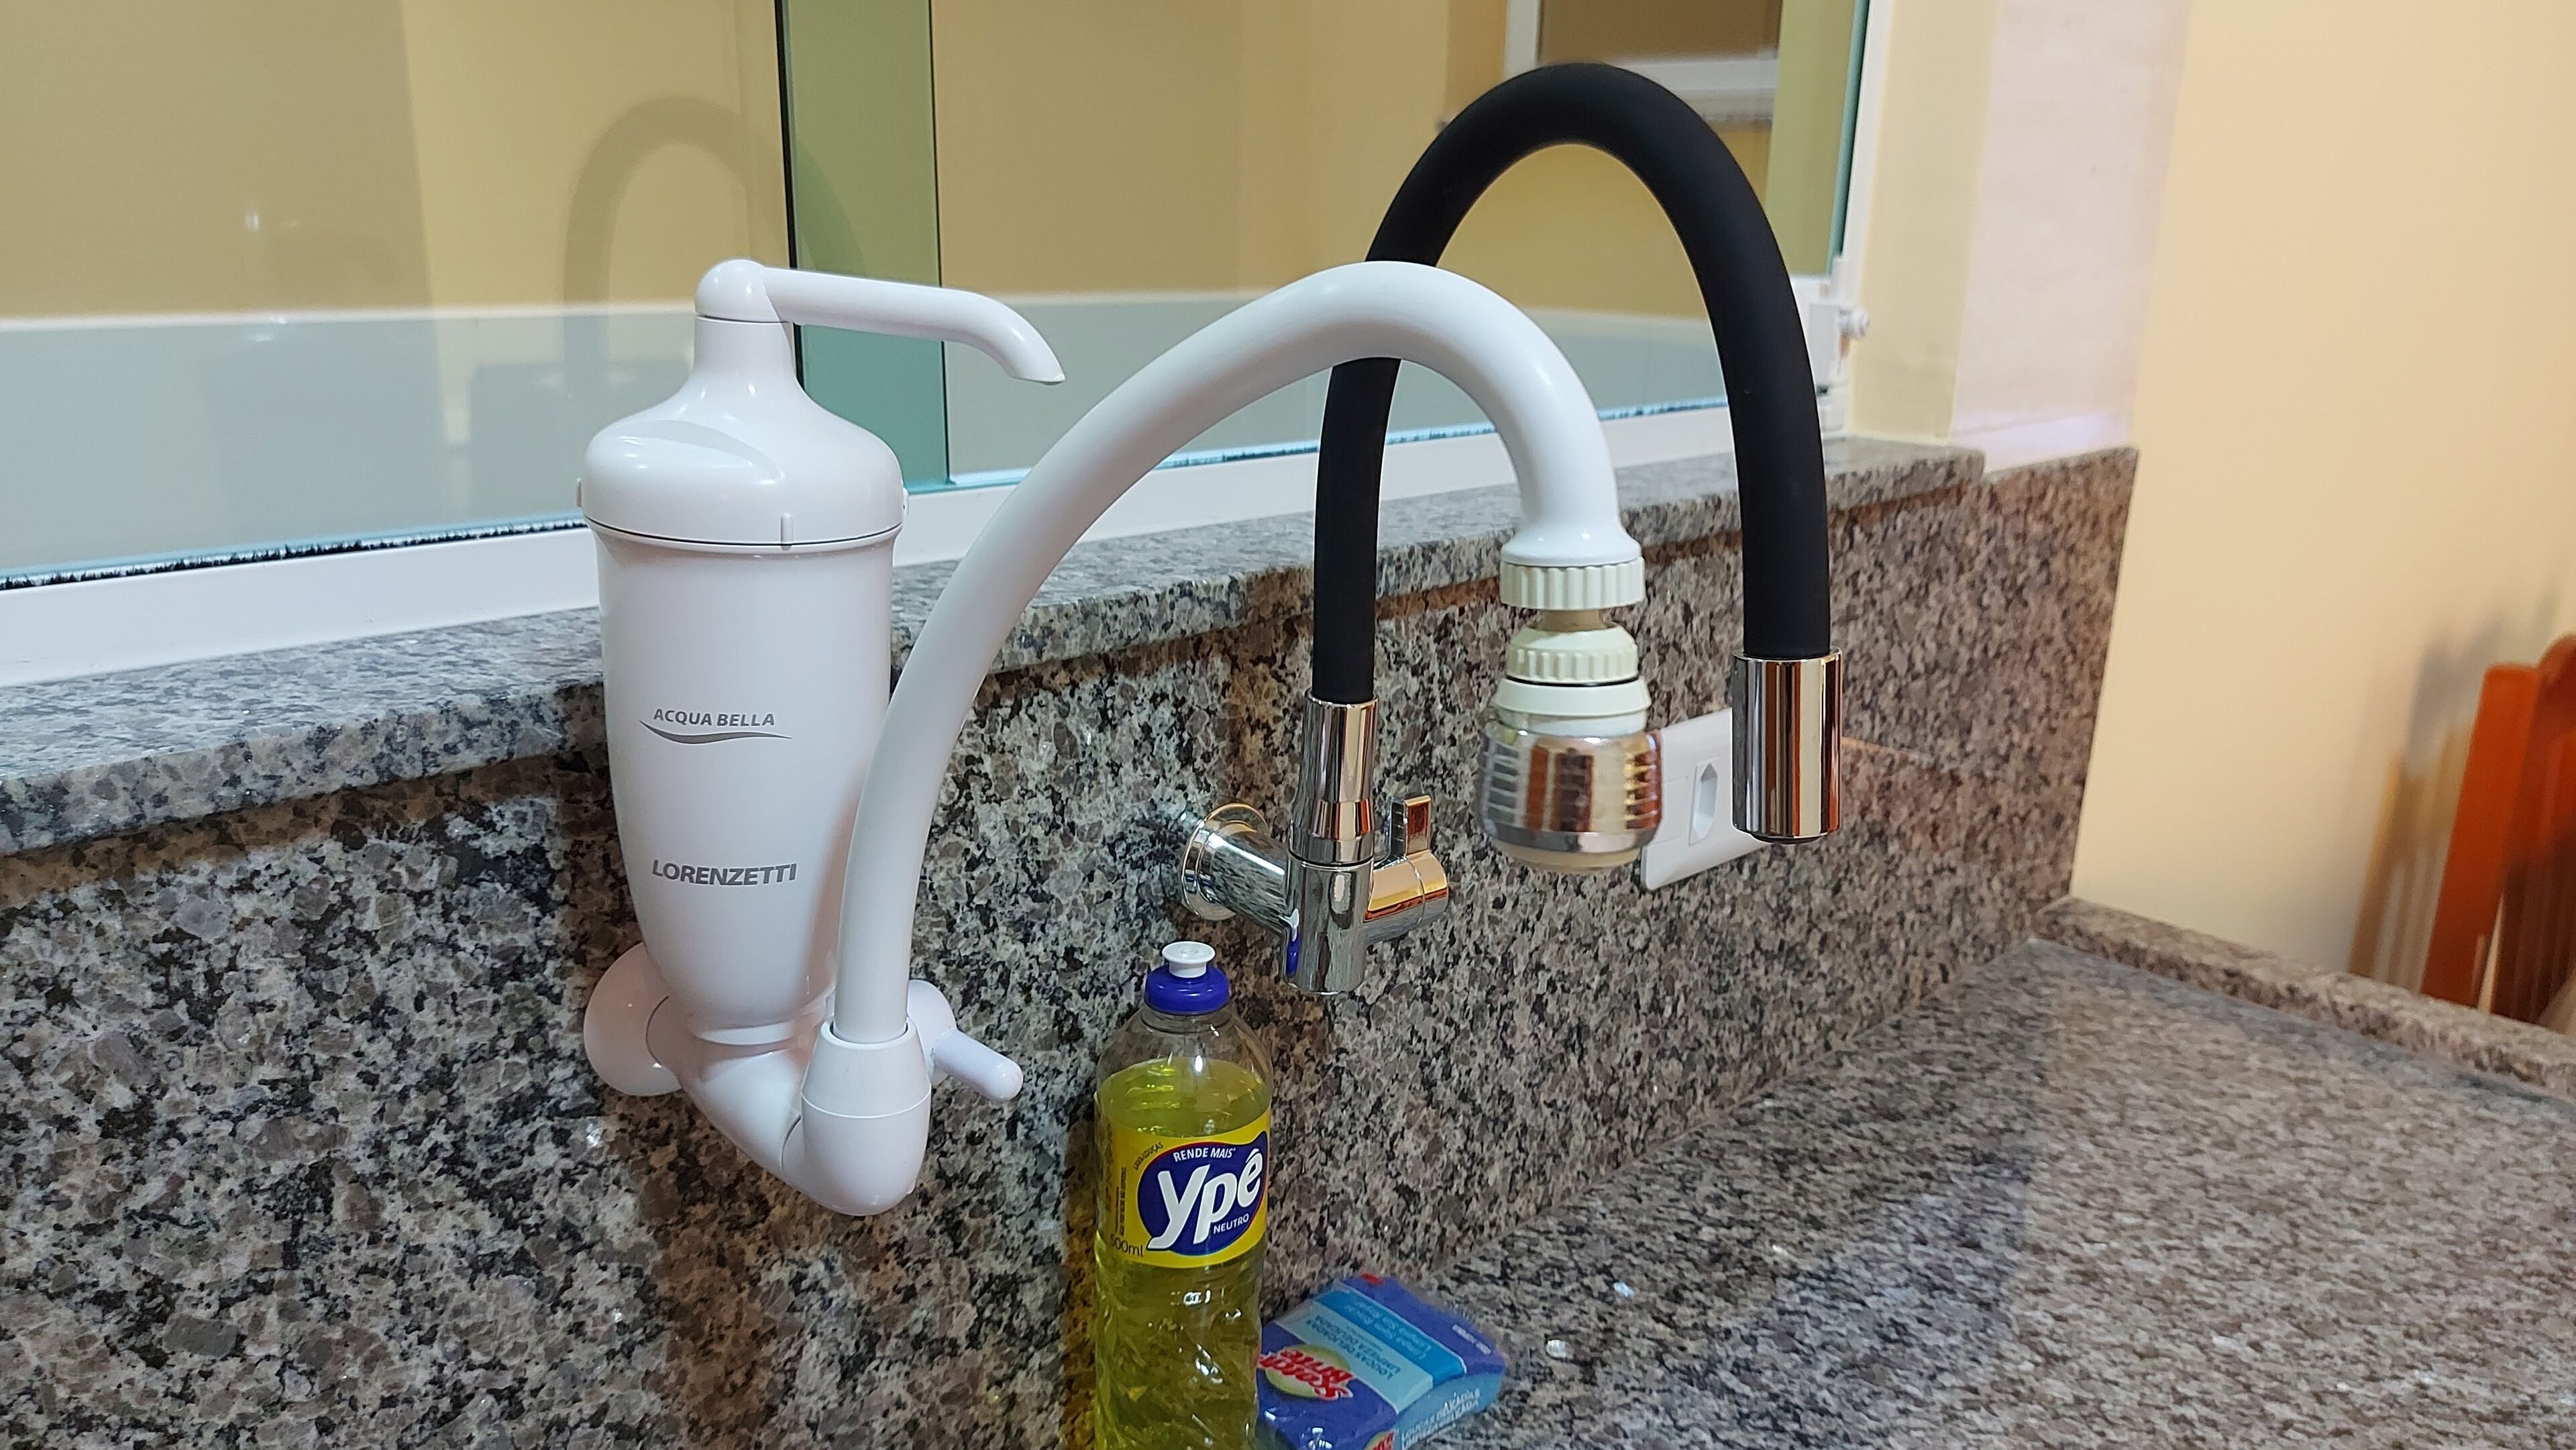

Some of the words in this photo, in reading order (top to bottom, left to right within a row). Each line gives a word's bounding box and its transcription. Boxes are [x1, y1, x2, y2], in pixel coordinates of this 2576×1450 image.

[653, 708, 712, 726] ACQUA
[716, 713, 775, 727] BELLA
[652, 859, 797, 886] LORENZETTI
[1173, 1148, 1208, 1162] RENDE
[1146, 1148, 1263, 1249] Ypê
[1213, 1213, 1249, 1235] NEUTRO
